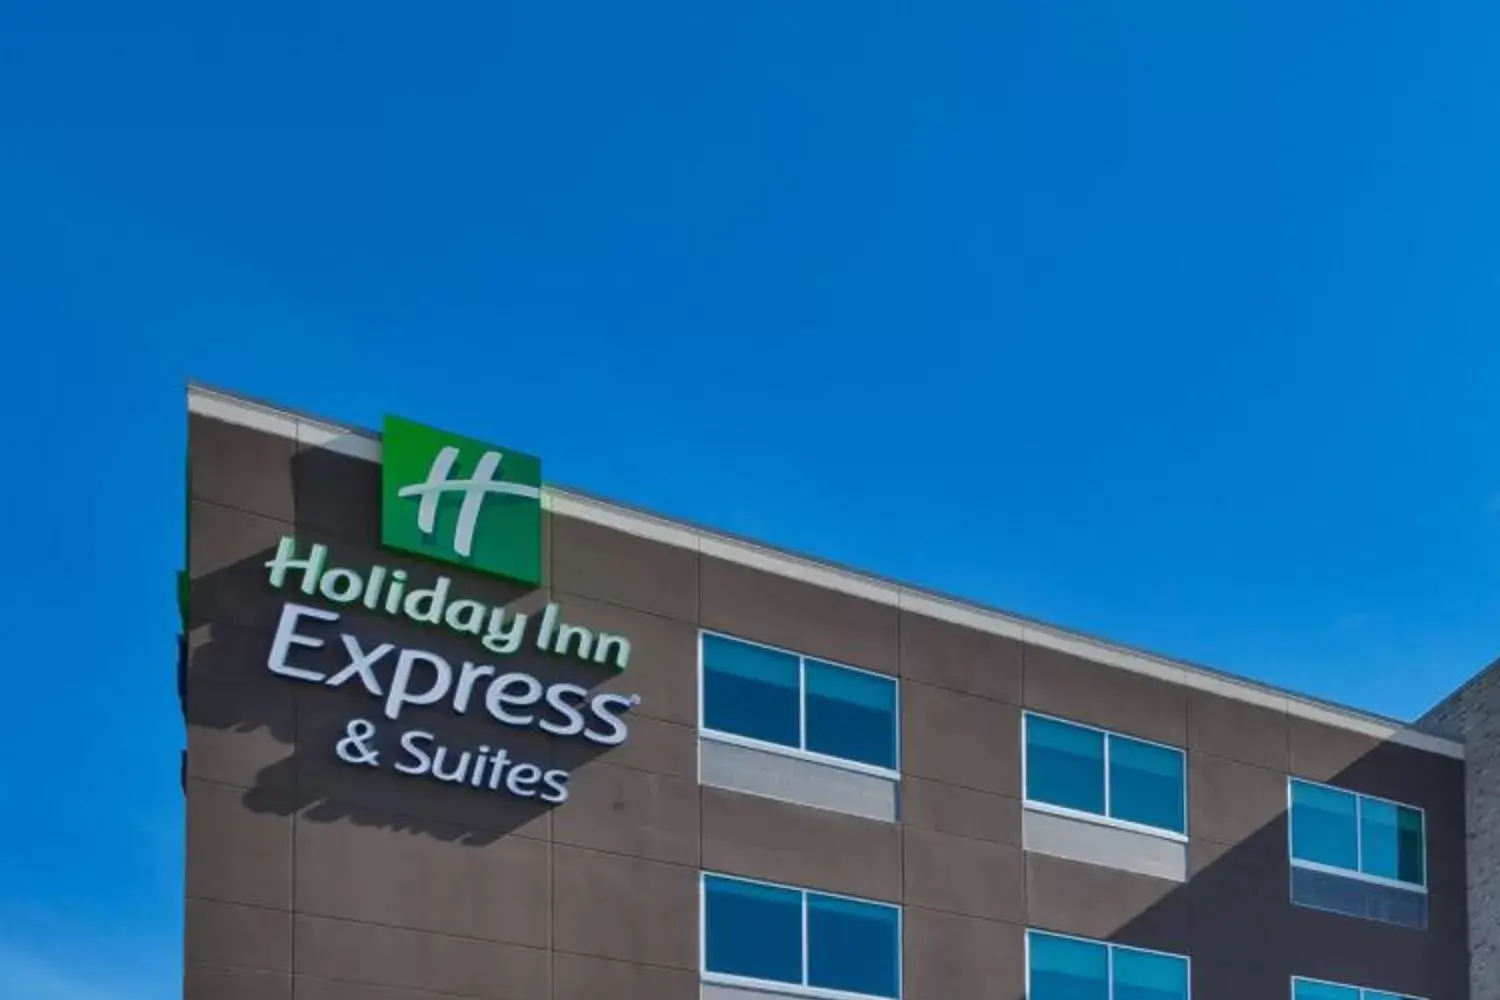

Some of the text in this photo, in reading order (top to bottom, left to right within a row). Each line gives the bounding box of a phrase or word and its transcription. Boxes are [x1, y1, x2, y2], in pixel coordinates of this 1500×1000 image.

[265, 536, 631, 669] Holiday Inn
[266, 602, 632, 746] Express
[335, 718, 569, 803] & Suites
